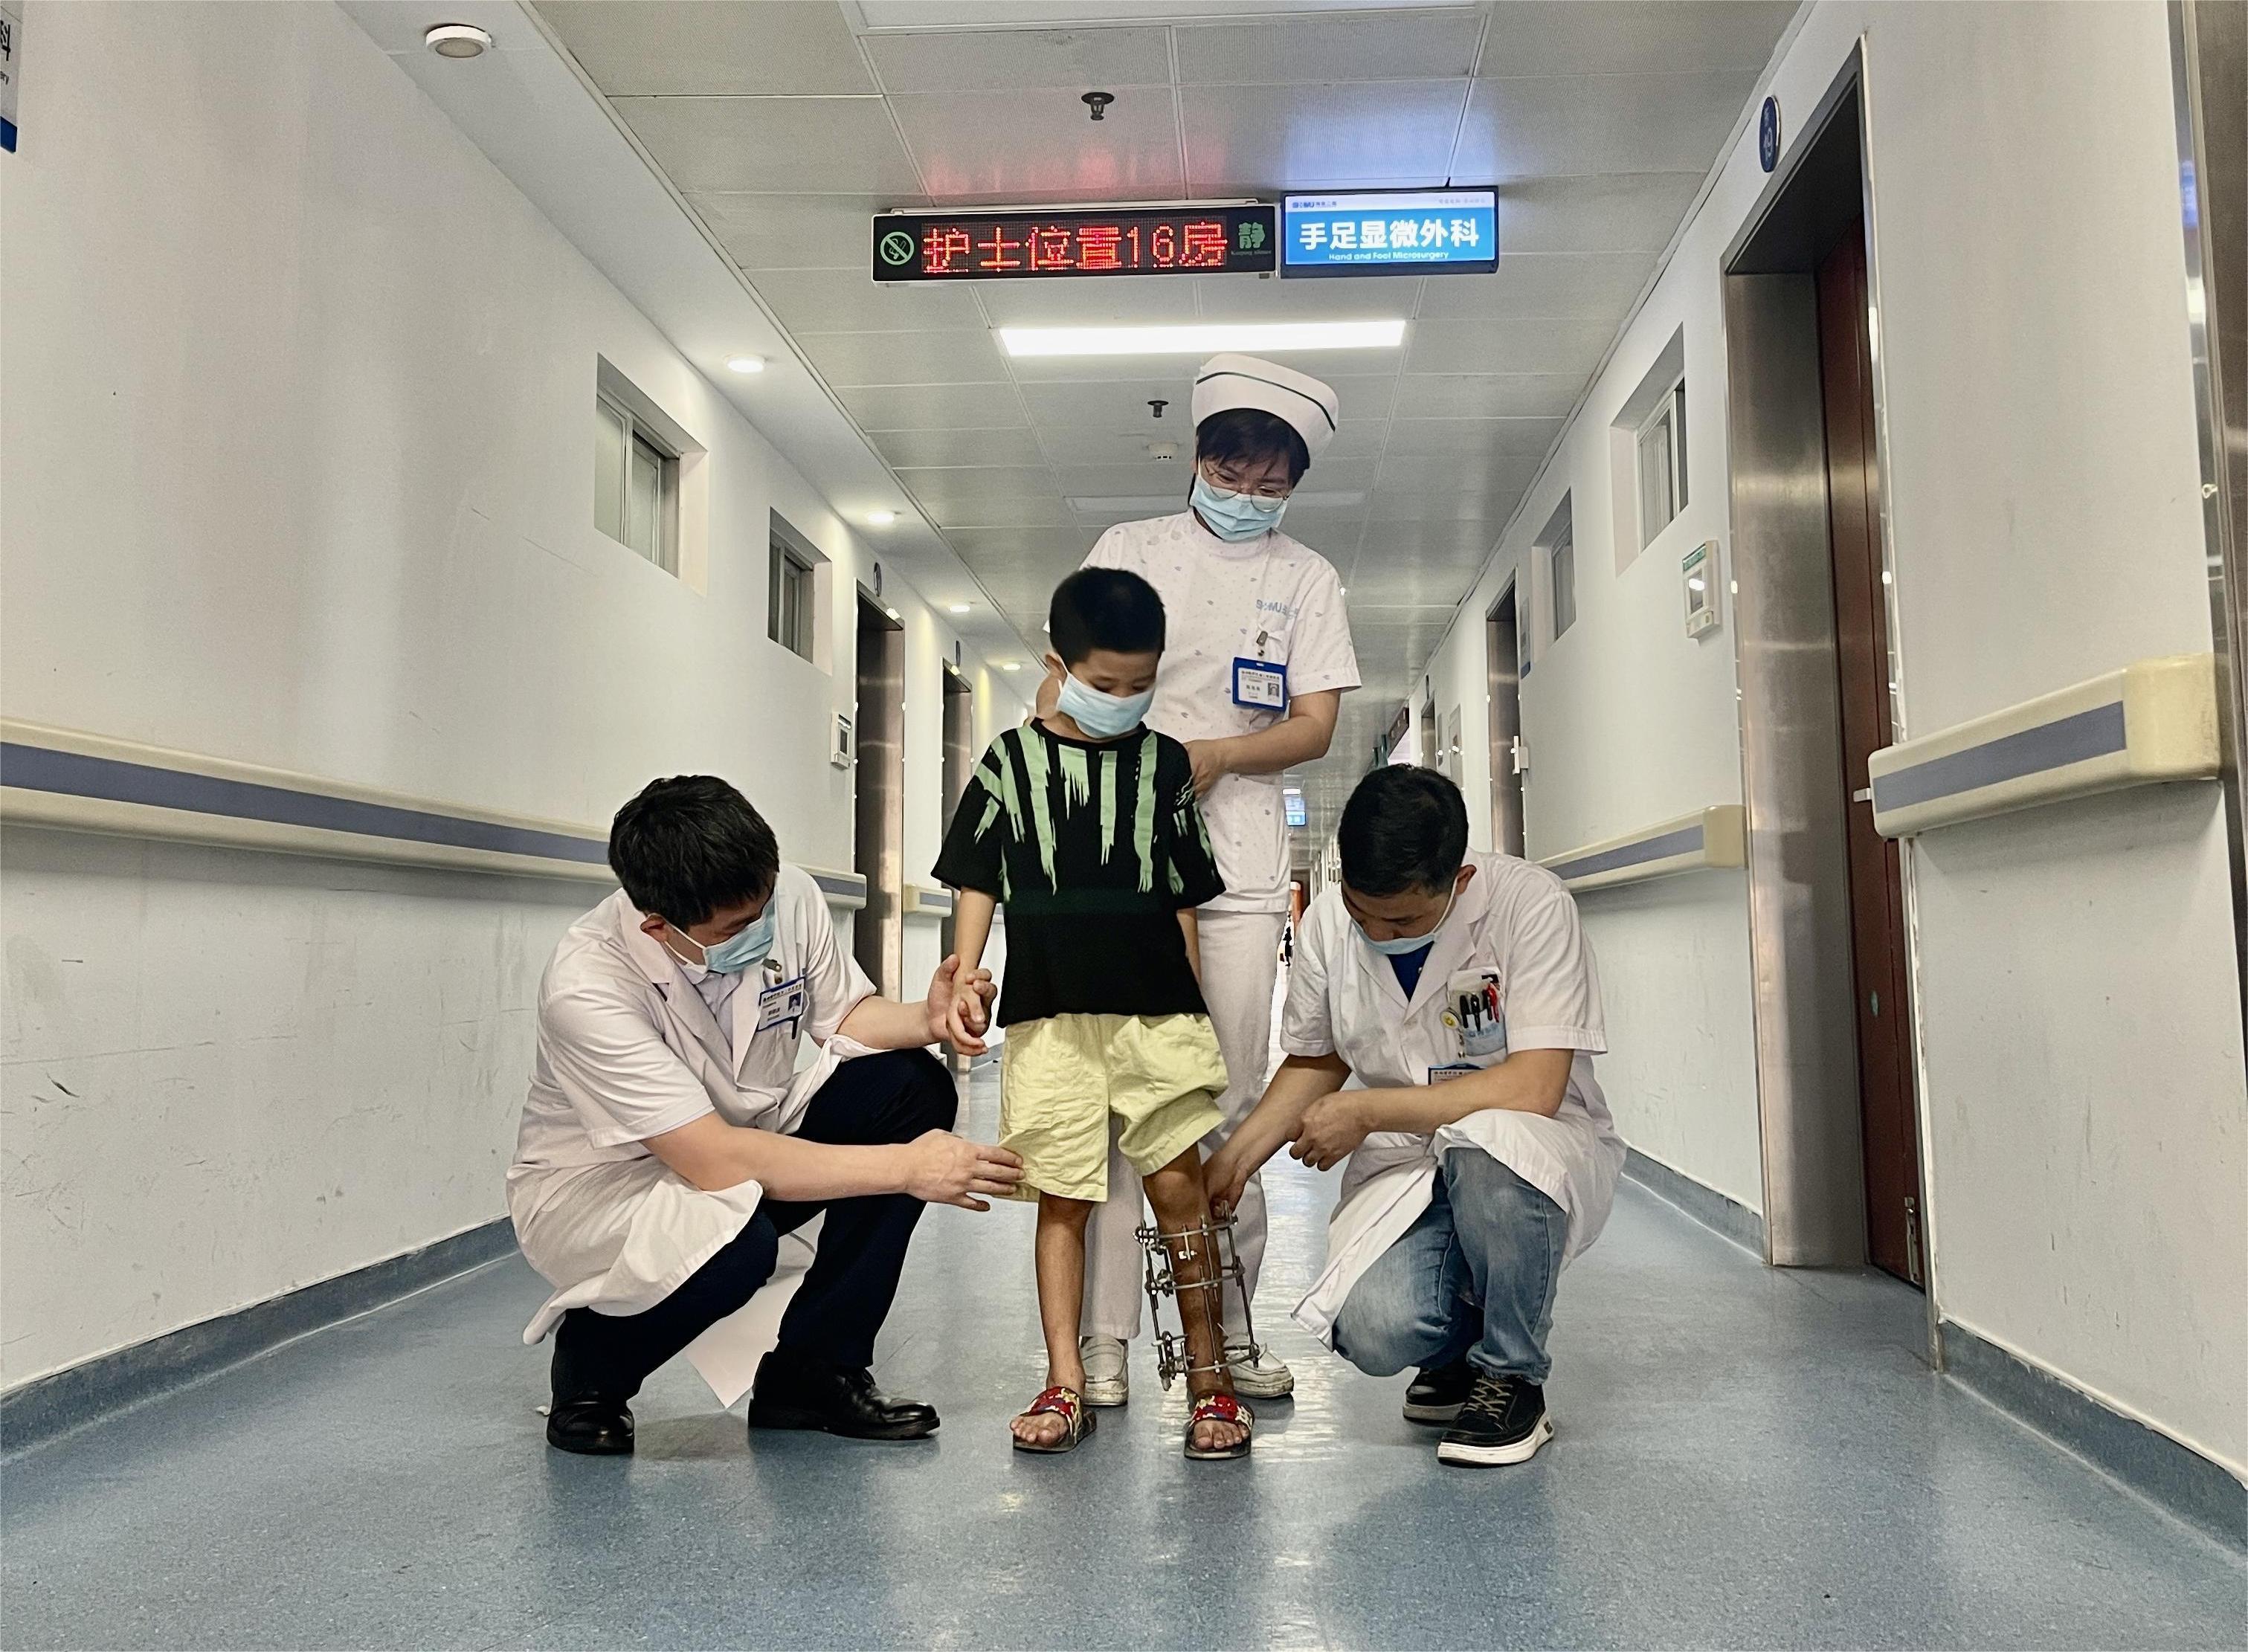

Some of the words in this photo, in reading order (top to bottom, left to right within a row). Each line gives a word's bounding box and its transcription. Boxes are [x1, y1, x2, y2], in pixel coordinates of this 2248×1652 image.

[1238, 222, 1266, 249] 静
[1299, 218, 1480, 251] 手足显微外科
[1393, 251, 1449, 259] Microsurgery
